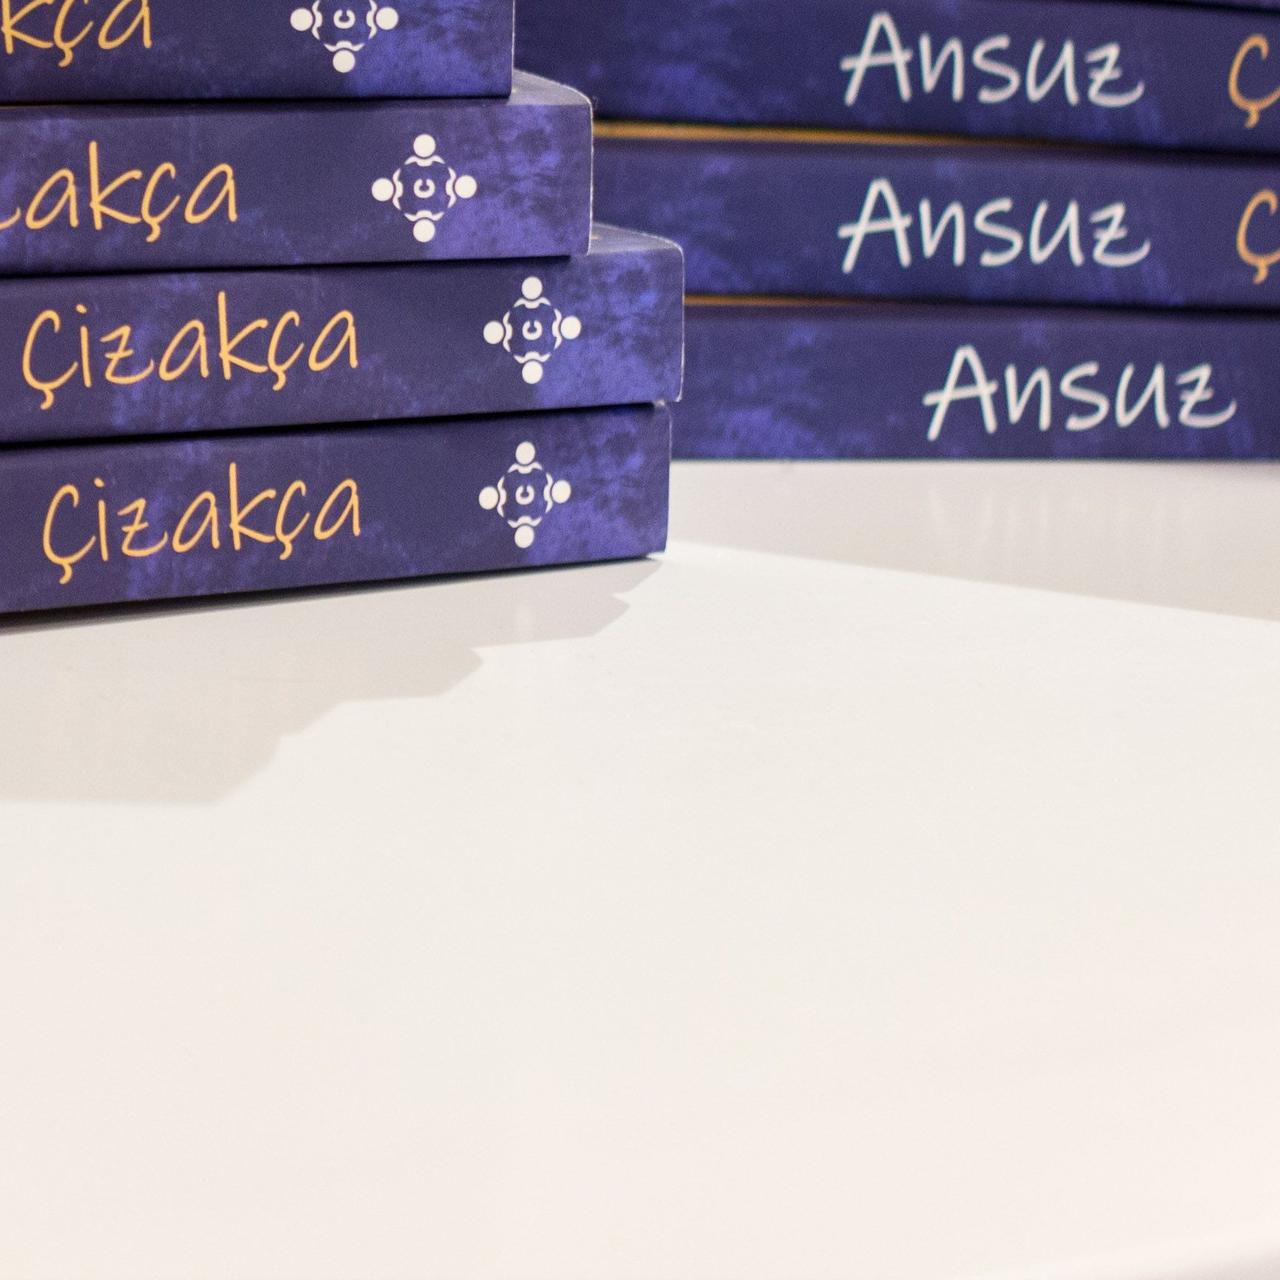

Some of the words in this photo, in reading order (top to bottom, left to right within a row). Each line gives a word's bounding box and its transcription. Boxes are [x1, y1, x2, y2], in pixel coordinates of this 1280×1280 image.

[839, 11, 1145, 109] Ansuz
[836, 177, 1152, 274] Ansuz
[20, 293, 360, 412] Çizakça
[921, 343, 1238, 442] Ansuz
[41, 461, 363, 586] Çizakça
